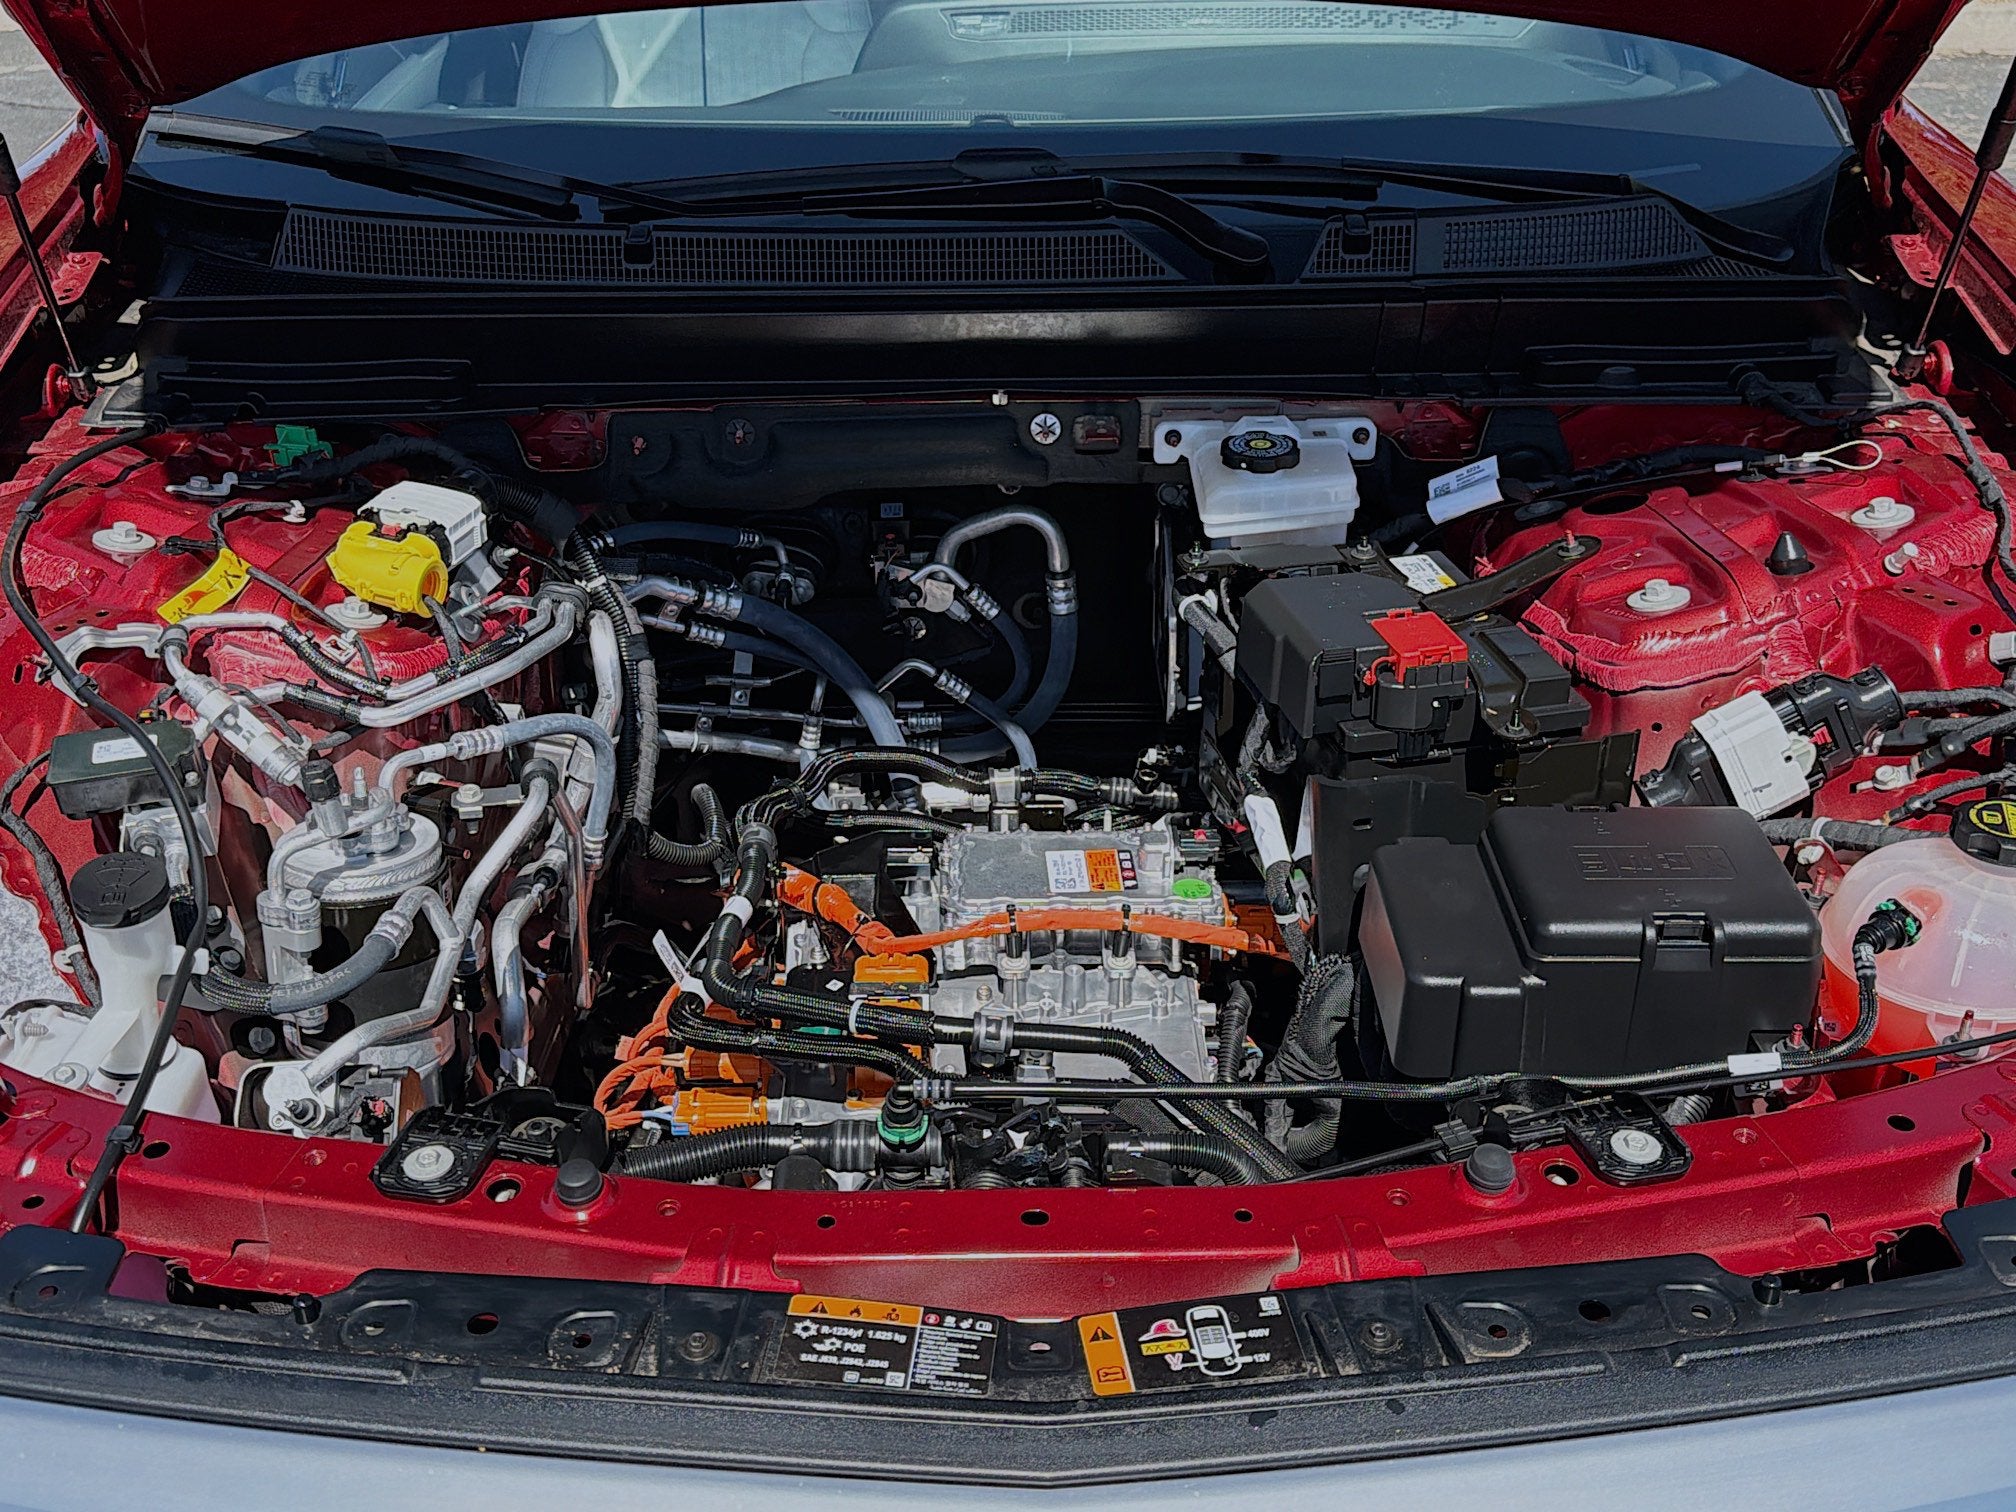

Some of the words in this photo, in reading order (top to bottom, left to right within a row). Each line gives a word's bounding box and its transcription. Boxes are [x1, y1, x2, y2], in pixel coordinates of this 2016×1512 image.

[821, 1325, 863, 1339] R-1234yf
[867, 1330, 893, 1340] 1.625
[893, 1332, 907, 1344] kg
[844, 1342, 866, 1353] POE
[800, 1353, 819, 1362] SAE
[1253, 1352, 1271, 1362] 12V
